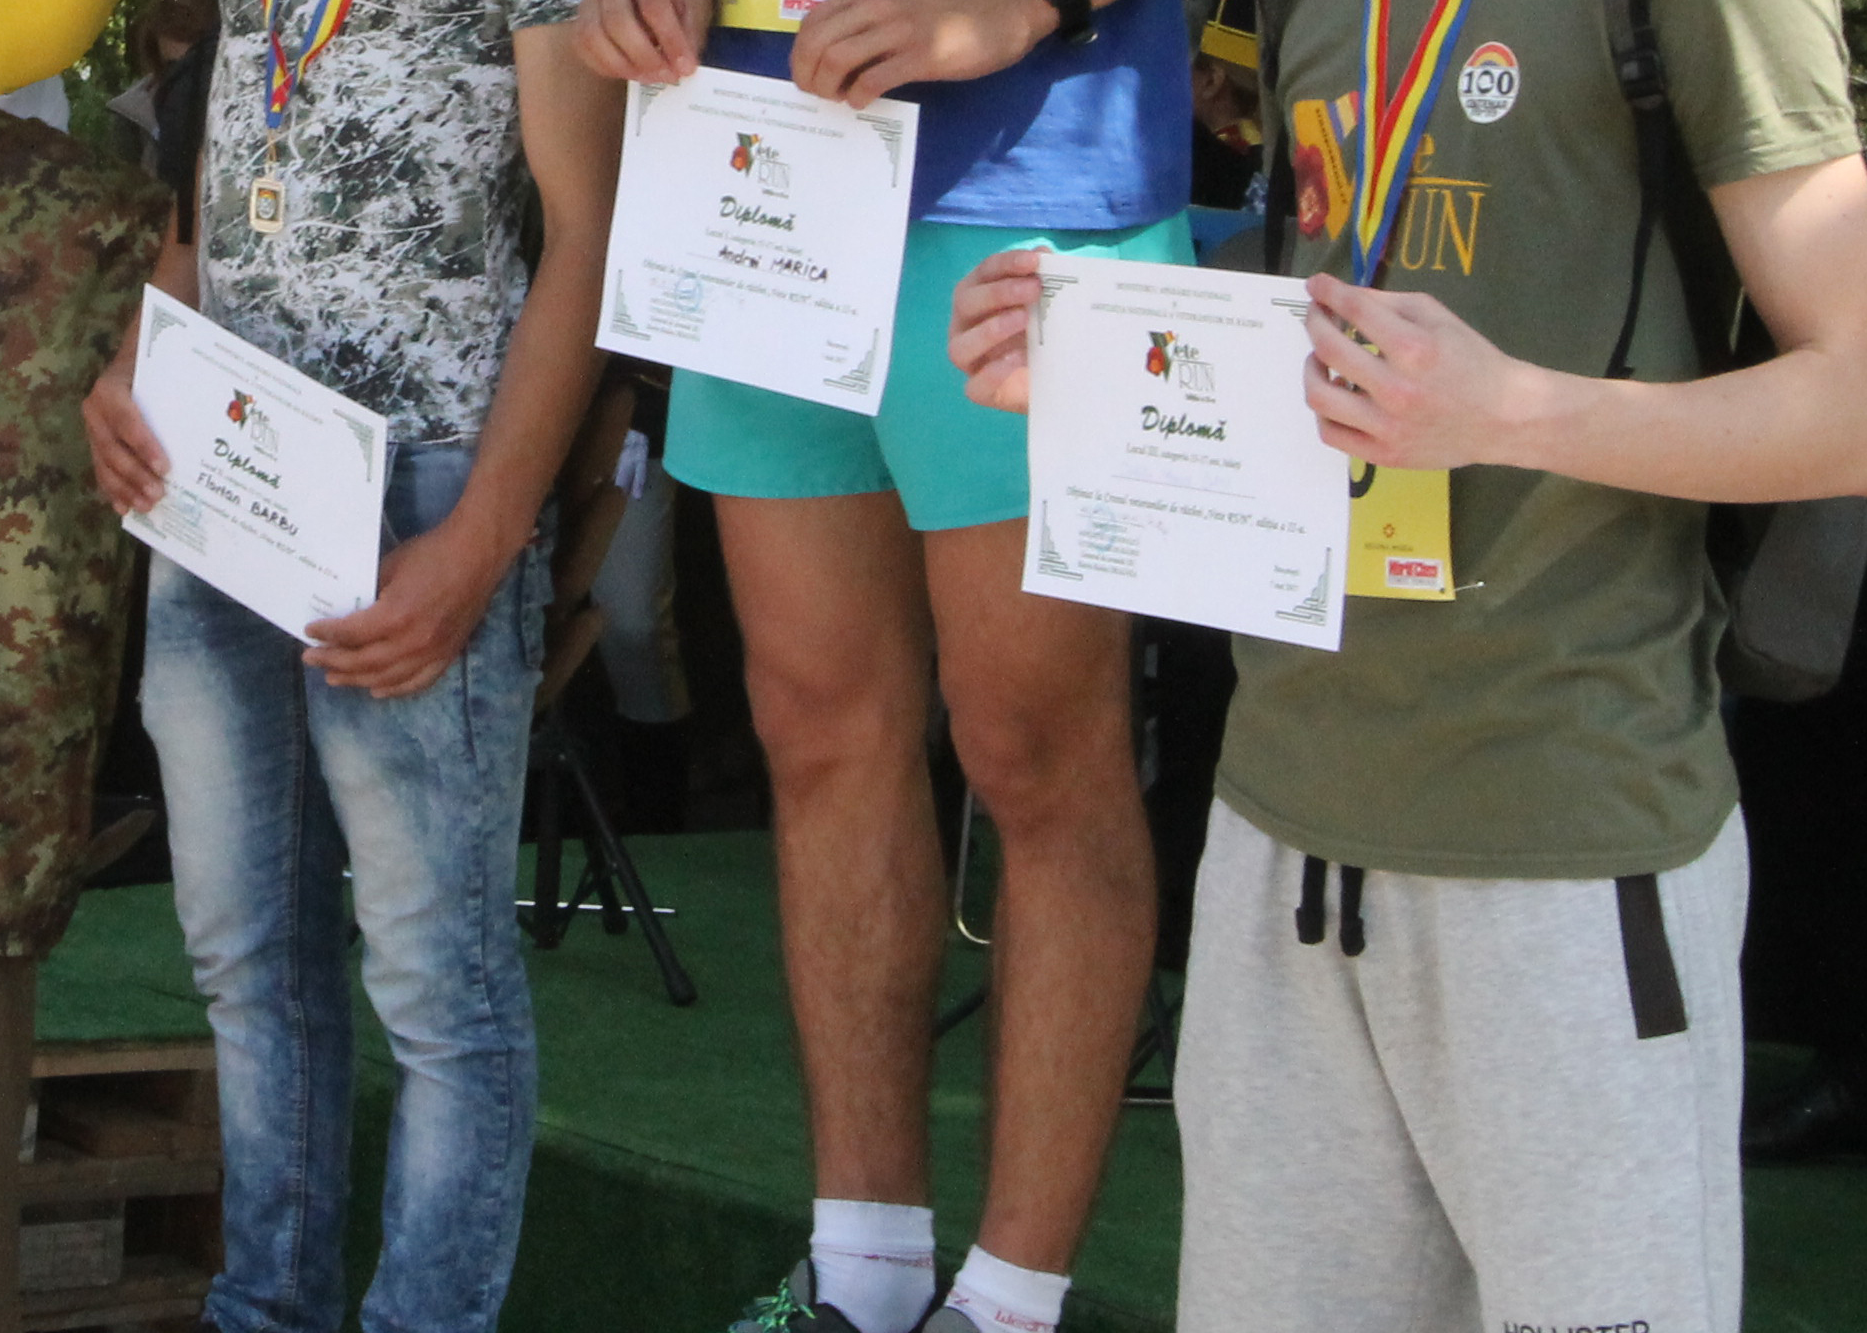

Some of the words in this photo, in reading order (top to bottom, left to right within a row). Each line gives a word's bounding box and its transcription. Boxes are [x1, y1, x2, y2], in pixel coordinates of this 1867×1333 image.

[1462, 69, 1514, 95] 100
[719, 195, 796, 232] Diplomă
[1141, 405, 1227, 442] Diplomă
[250, 501, 299, 536] BARBU
